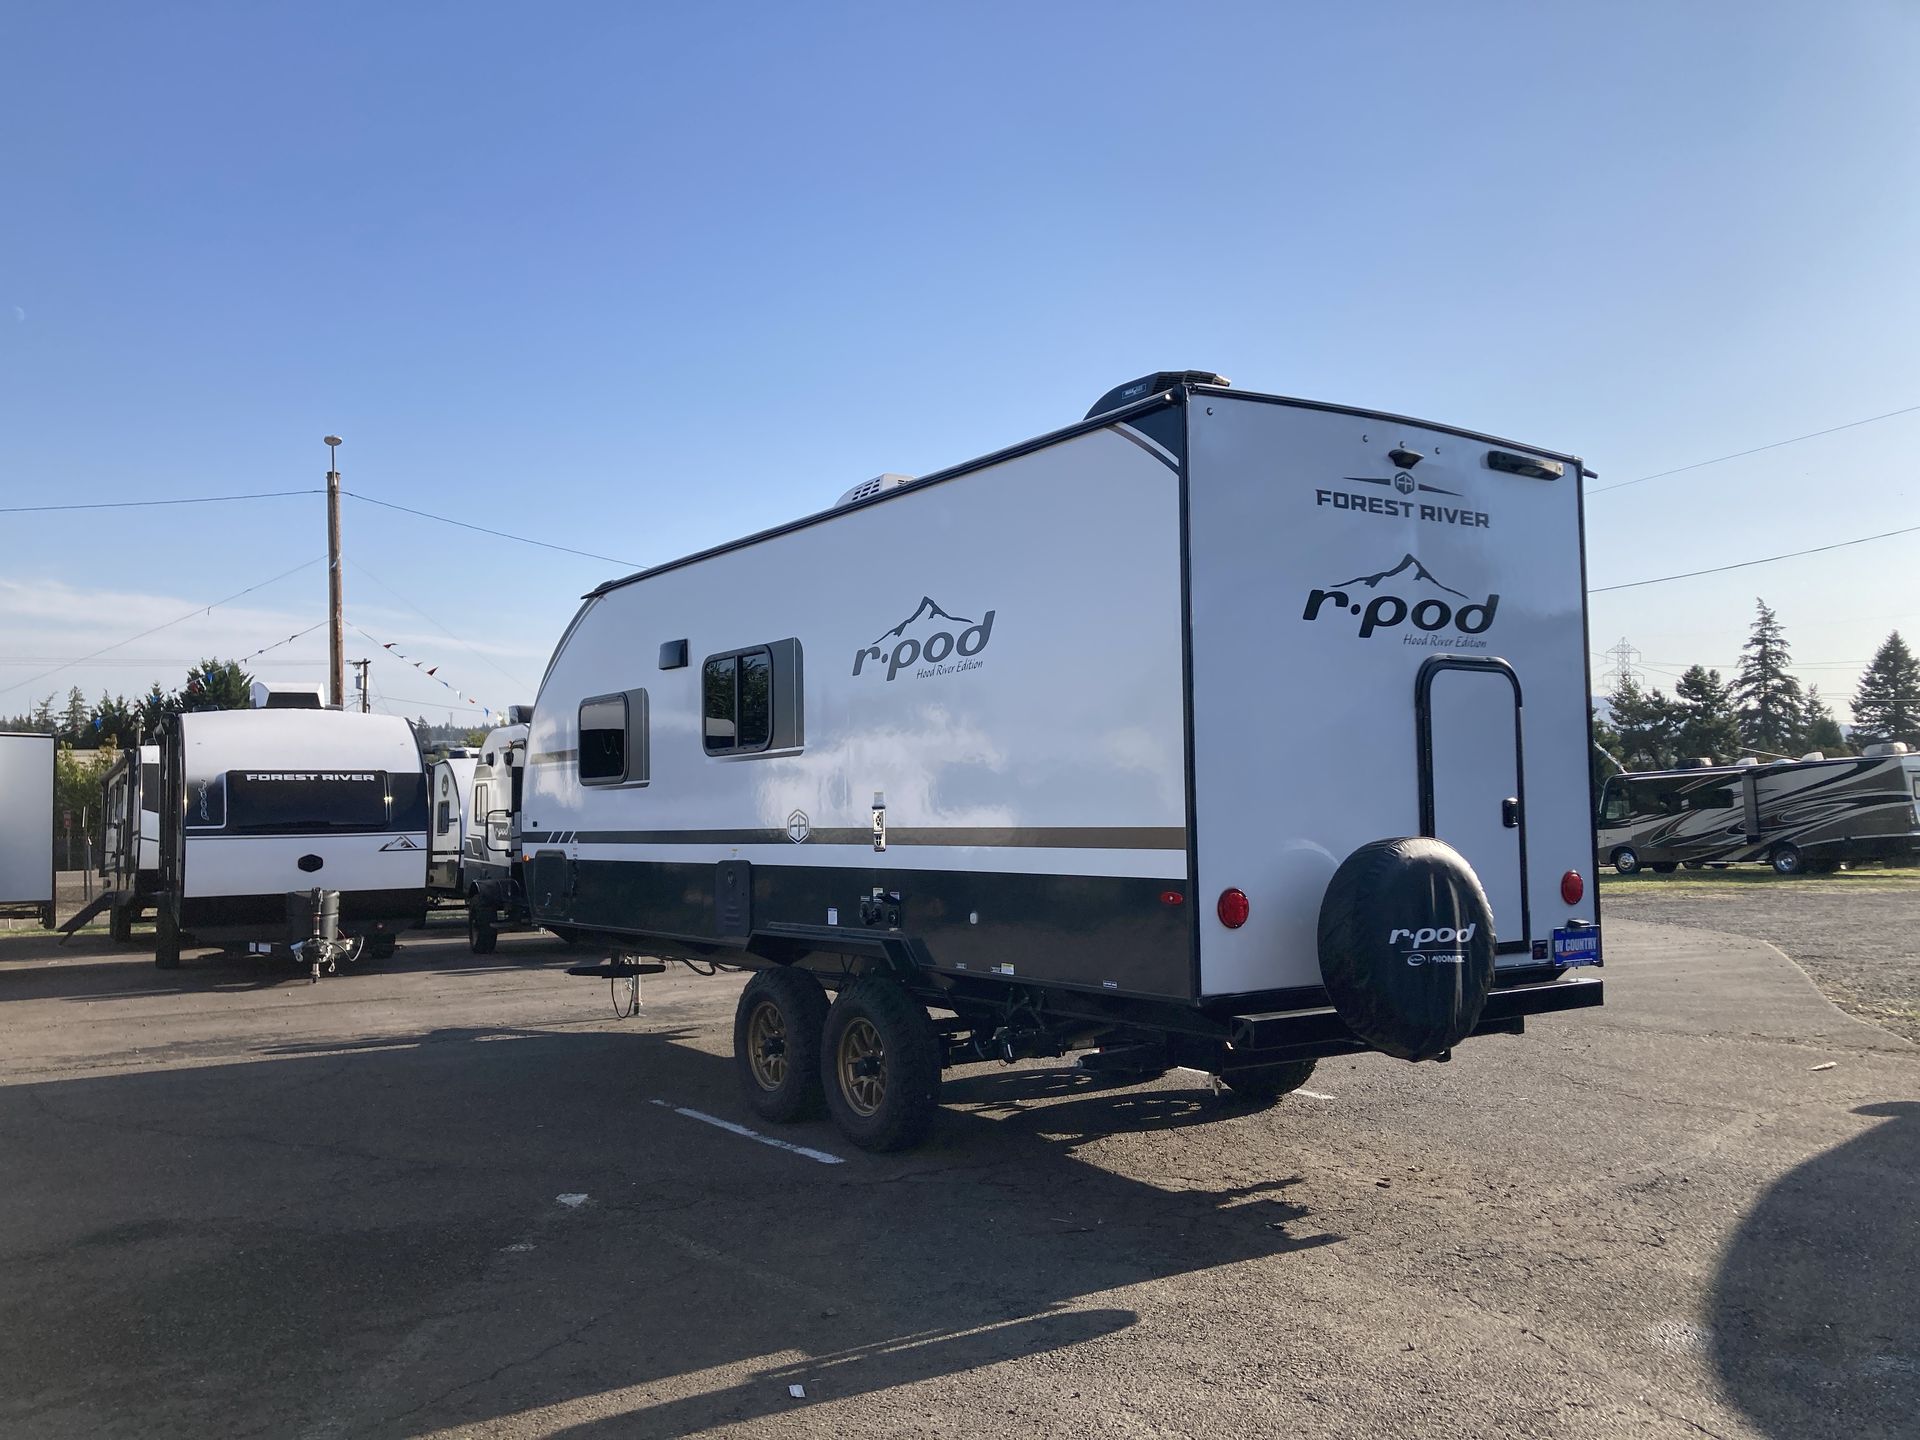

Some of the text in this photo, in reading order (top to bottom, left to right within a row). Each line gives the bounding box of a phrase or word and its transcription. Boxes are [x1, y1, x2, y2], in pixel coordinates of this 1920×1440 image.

[1315, 489, 1490, 528] FOREST RIVER
[1403, 633, 1487, 648] Hood River Edition
[916, 659, 983, 679] Hood River Edition
[1565, 937, 1597, 951] COUNTRY
